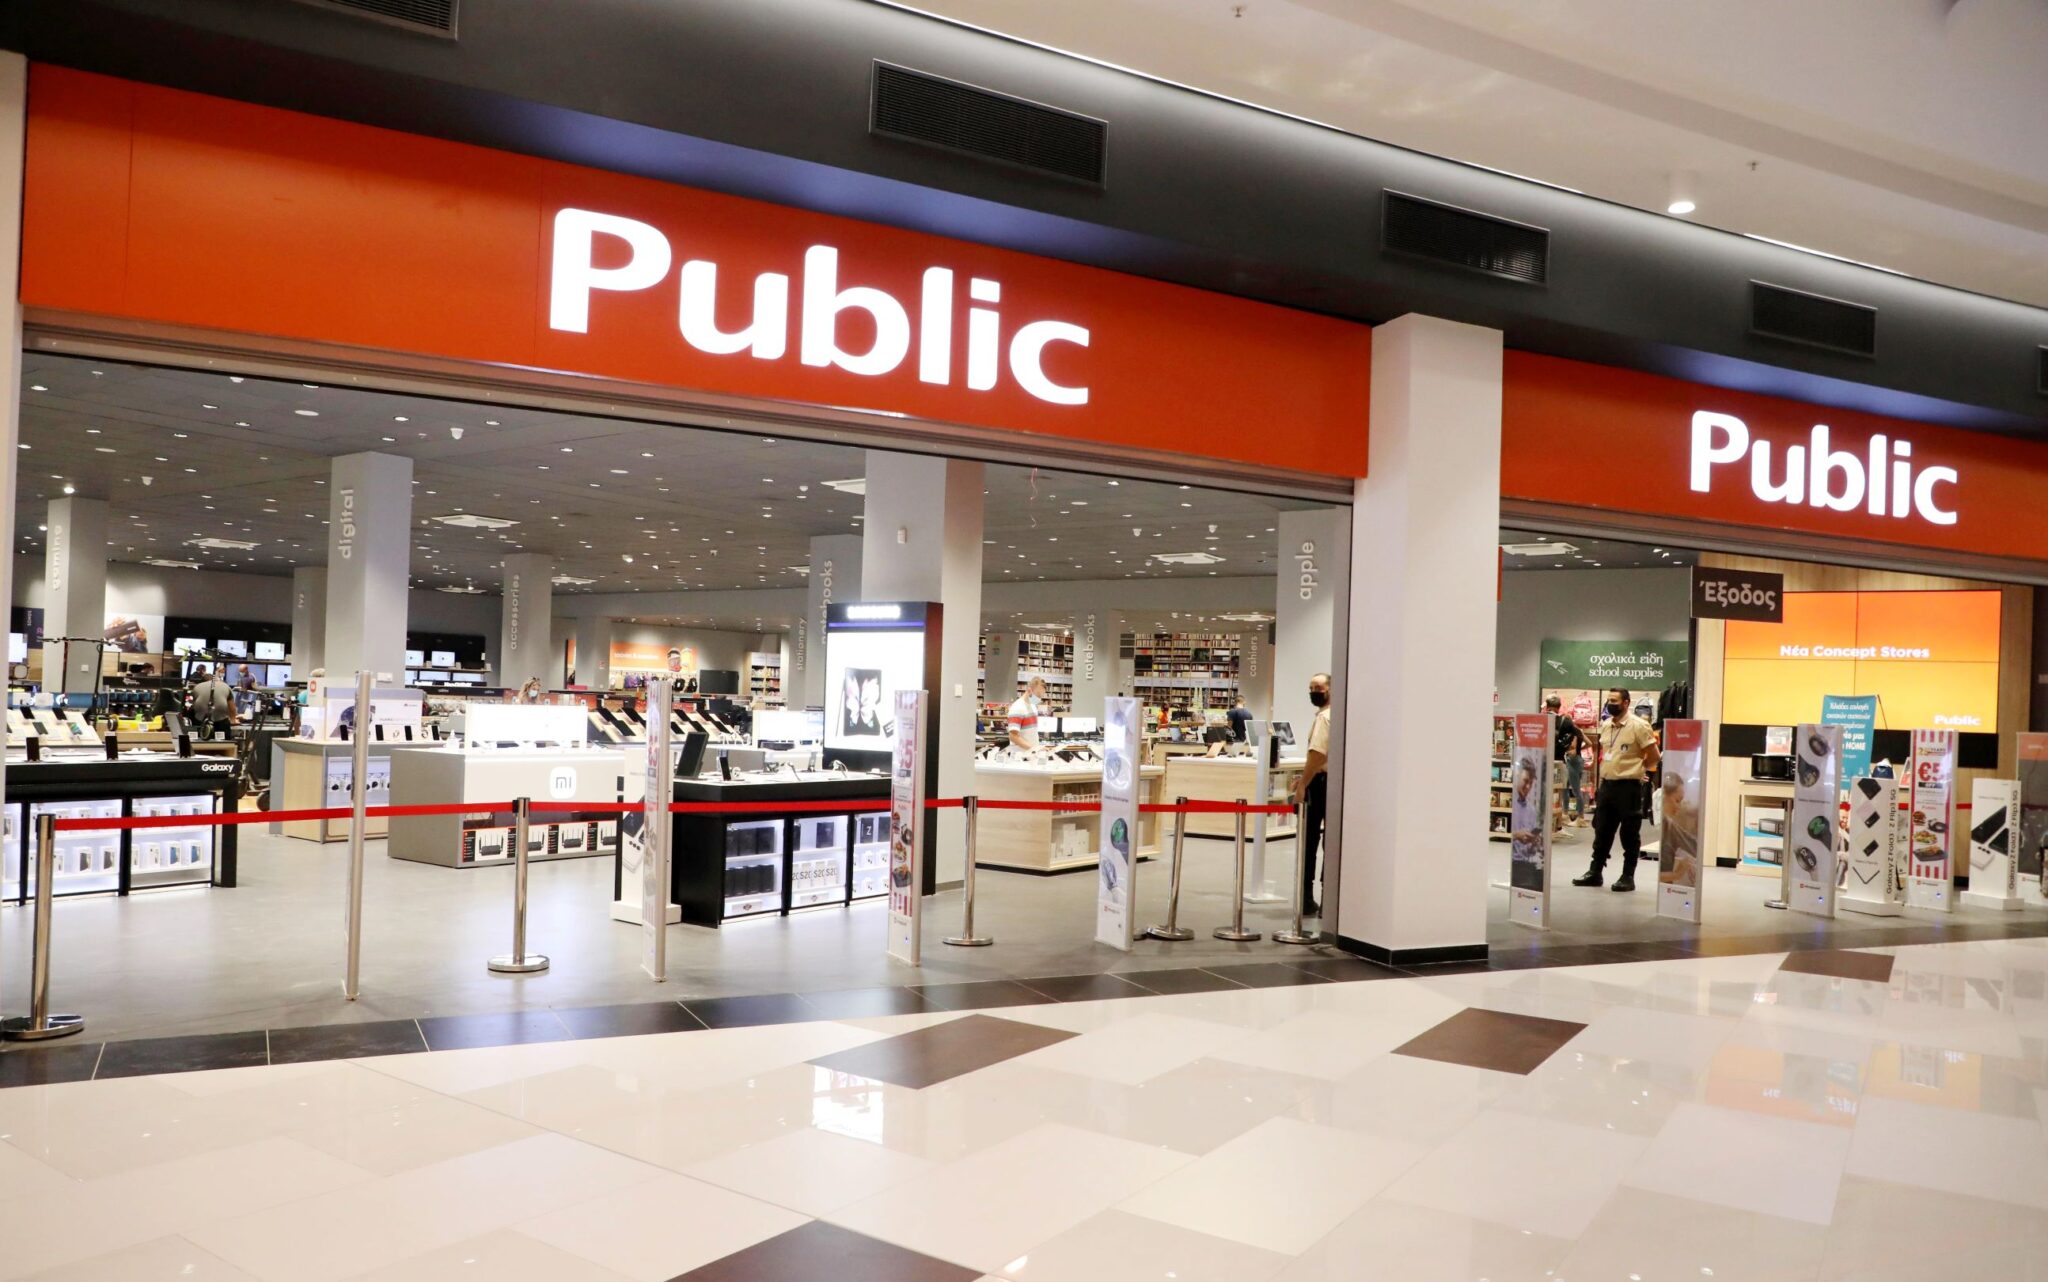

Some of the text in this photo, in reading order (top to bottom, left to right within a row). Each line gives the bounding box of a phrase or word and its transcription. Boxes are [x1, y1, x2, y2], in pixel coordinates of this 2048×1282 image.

[550, 208, 1089, 405] Public
[1690, 410, 1958, 525] Public
[337, 488, 356, 559] digital
[1295, 541, 1318, 600] apple
[1699, 580, 1776, 611] Έξοδος
[510, 574, 520, 650] accessories
[795, 616, 807, 671] stationery
[1083, 613, 1095, 680] notebooks
[1247, 635, 1258, 677] cashiers
[1589, 651, 1664, 667] σχολικά είδη
[1780, 645, 1930, 659] Νέα Concept Stores
[1588, 665, 1664, 680] school supplies
[1934, 713, 1981, 727] Public
[201, 763, 234, 773] Galaxy
[1890, 789, 1897, 801] 5G
[1886, 864, 1895, 894] Galaxy
[2009, 861, 2017, 890] Galaxy
